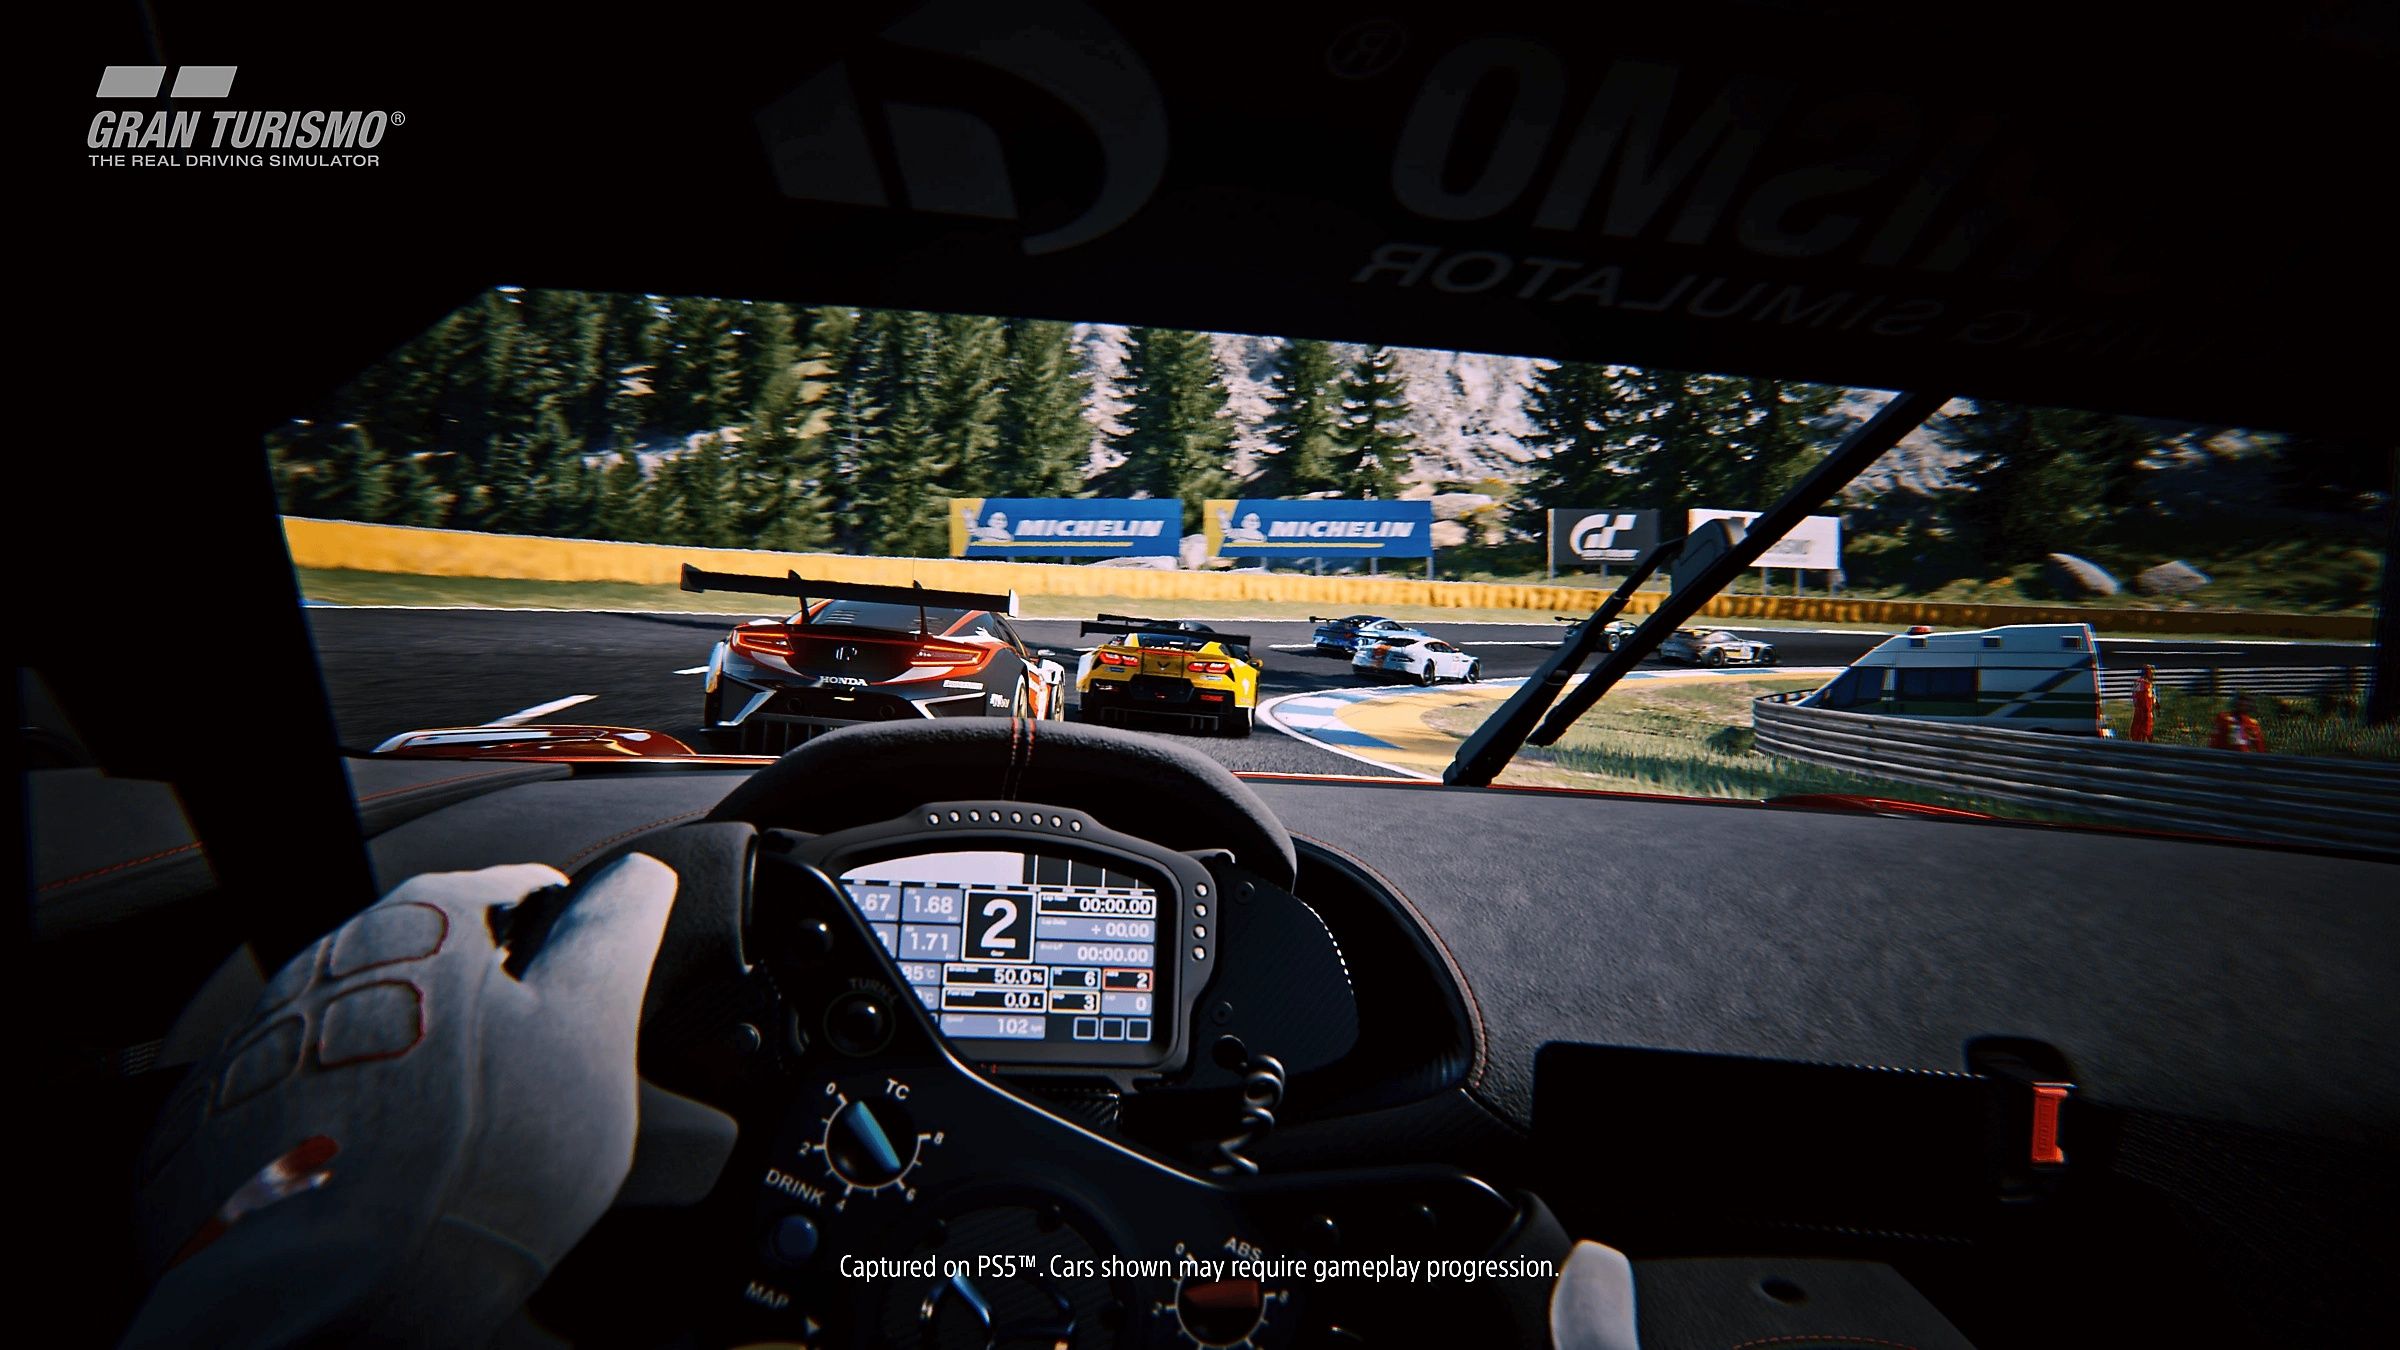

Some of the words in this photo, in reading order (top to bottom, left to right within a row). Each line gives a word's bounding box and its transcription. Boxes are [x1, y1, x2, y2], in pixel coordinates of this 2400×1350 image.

[1014, 519, 1165, 537] MICHELIN
[1267, 520, 1416, 538] MICHELIN
[819, 675, 869, 687] HONDA
[913, 894, 954, 914] 1.68
[1080, 897, 1151, 914] 00:00.00
[980, 898, 1018, 949] 2
[910, 932, 949, 951] 1.71
[1077, 946, 1149, 963] 00:00.00
[1084, 970, 1096, 987] 6
[1136, 972, 1149, 989] 2
[1004, 992, 1031, 1009] 0.0
[1083, 994, 1095, 1011] 3
[1135, 996, 1148, 1011] 0
[997, 1018, 1029, 1034] 102
[885, 1077, 911, 1100] TC
[764, 1168, 827, 1207] DRINK
[1222, 1234, 1264, 1262] ABS
[745, 1280, 790, 1309] MAP
